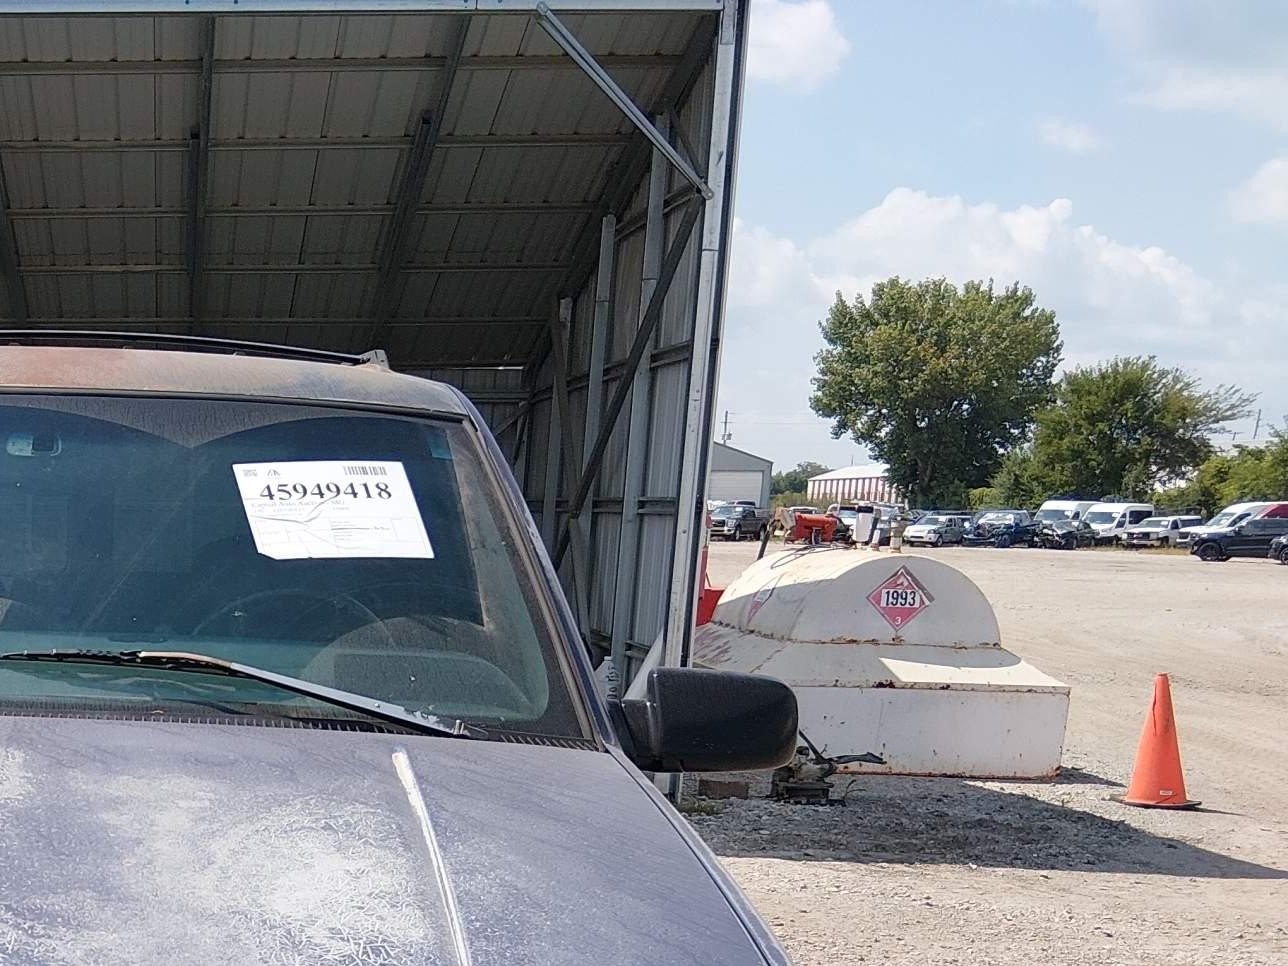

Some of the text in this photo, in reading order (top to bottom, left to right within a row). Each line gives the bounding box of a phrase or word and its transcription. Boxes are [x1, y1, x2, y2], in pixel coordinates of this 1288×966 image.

[259, 482, 392, 501] 45949418
[885, 590, 917, 607] 1993
[895, 616, 902, 625] 3
